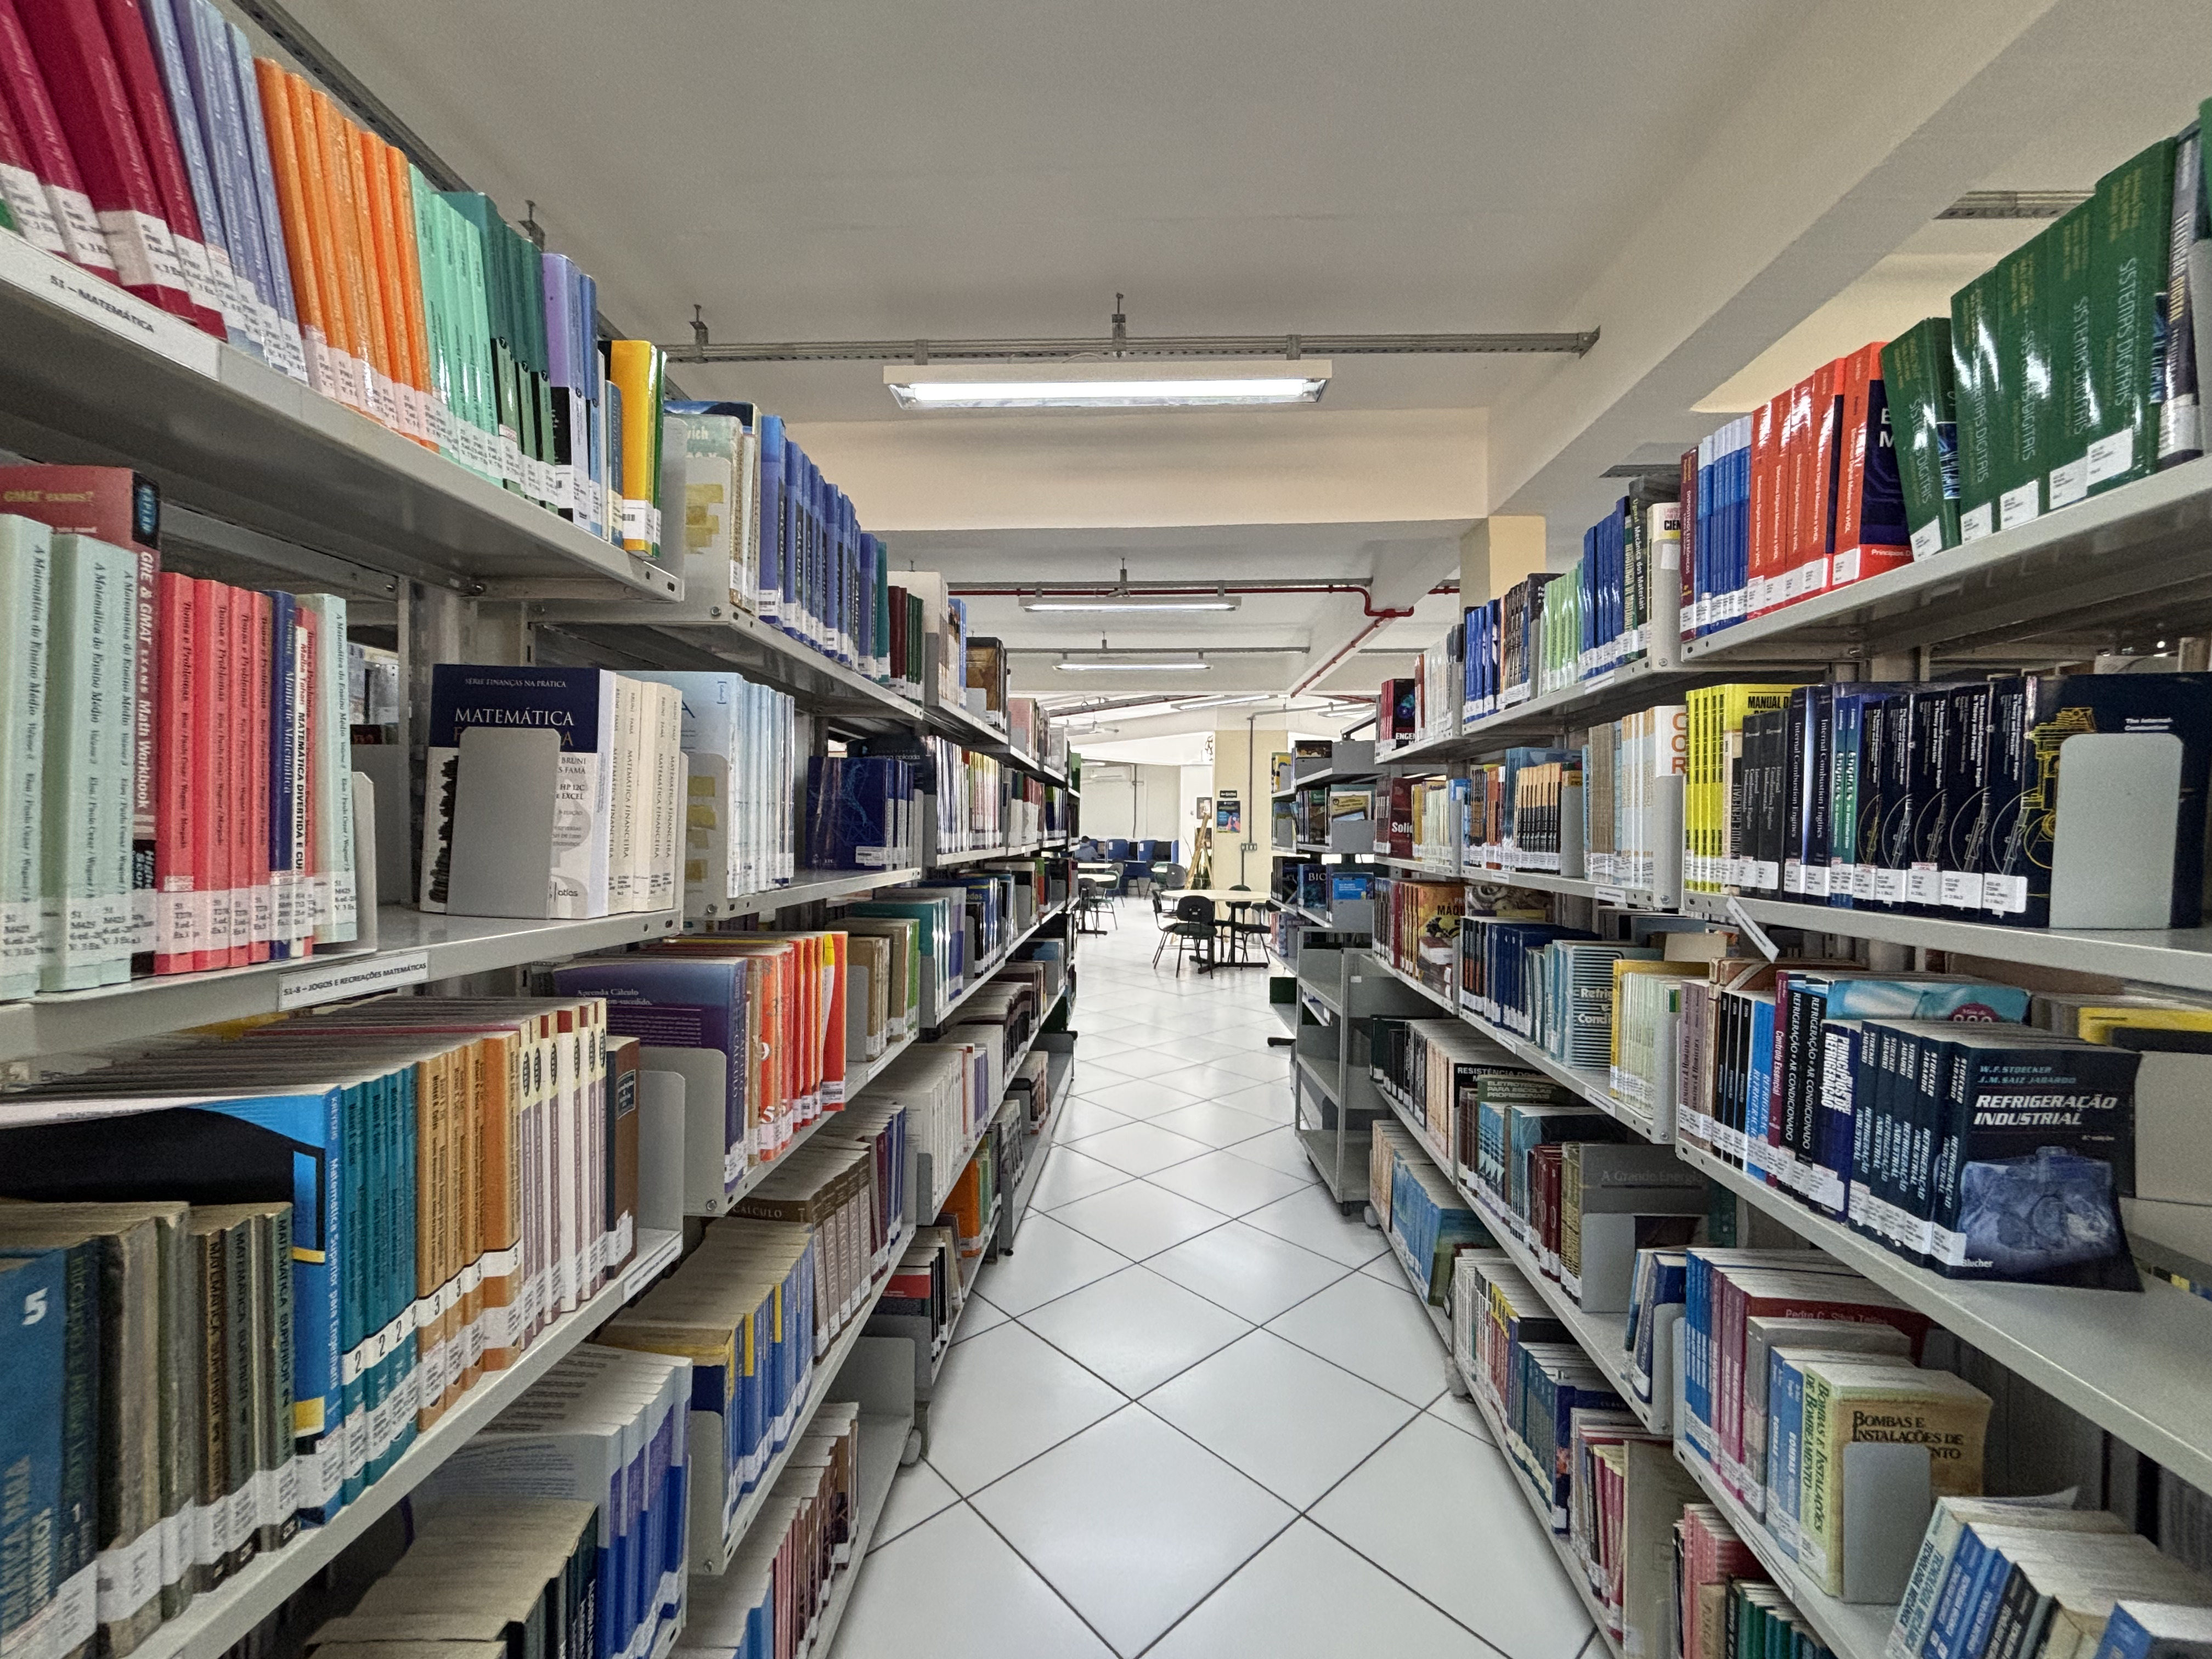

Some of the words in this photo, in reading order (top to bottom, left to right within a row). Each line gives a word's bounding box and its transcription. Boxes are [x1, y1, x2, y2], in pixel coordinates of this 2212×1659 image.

[2118, 258, 2137, 337] SISTEMAS
[2115, 340, 2133, 406] DIGITAIS
[139, 551, 154, 583] GRE
[138, 602, 154, 647] GMAT
[138, 700, 151, 737] Math
[454, 707, 575, 726] MATEMÁTICA
[1748, 696, 1781, 709] MANUAL
[296, 713, 306, 782] MATEMÁTICA
[136, 738, 151, 809] Workbook
[296, 784, 305, 839] DIVERTIDA
[308, 980, 333, 991] JOGOS
[340, 970, 382, 985] RECREAÇÕES
[382, 962, 427, 978] MATEMÁTICAS
[1790, 992, 1801, 1053] REFRIGERAÇÃO
[1807, 997, 1820, 1061] REFRIGERAÇÃO
[1785, 1073, 1797, 1142] CONDICIONADO
[1802, 1079, 1815, 1150] CONDICIONADO
[1973, 1112, 2082, 1125] INDUSTRIAL
[1975, 1094, 2118, 1111] REFRIGERAÇÃO
[330, 1159, 338, 1233] Matemática
[329, 1234, 338, 1286] Superior
[22, 1287, 49, 1325] 5
[328, 1289, 338, 1319] para
[411, 1305, 417, 1327] 2
[379, 1334, 386, 1357] 2
[396, 1320, 402, 1343] 2
[354, 1350, 362, 1374] 2
[1944, 1434, 1964, 1445] DE
